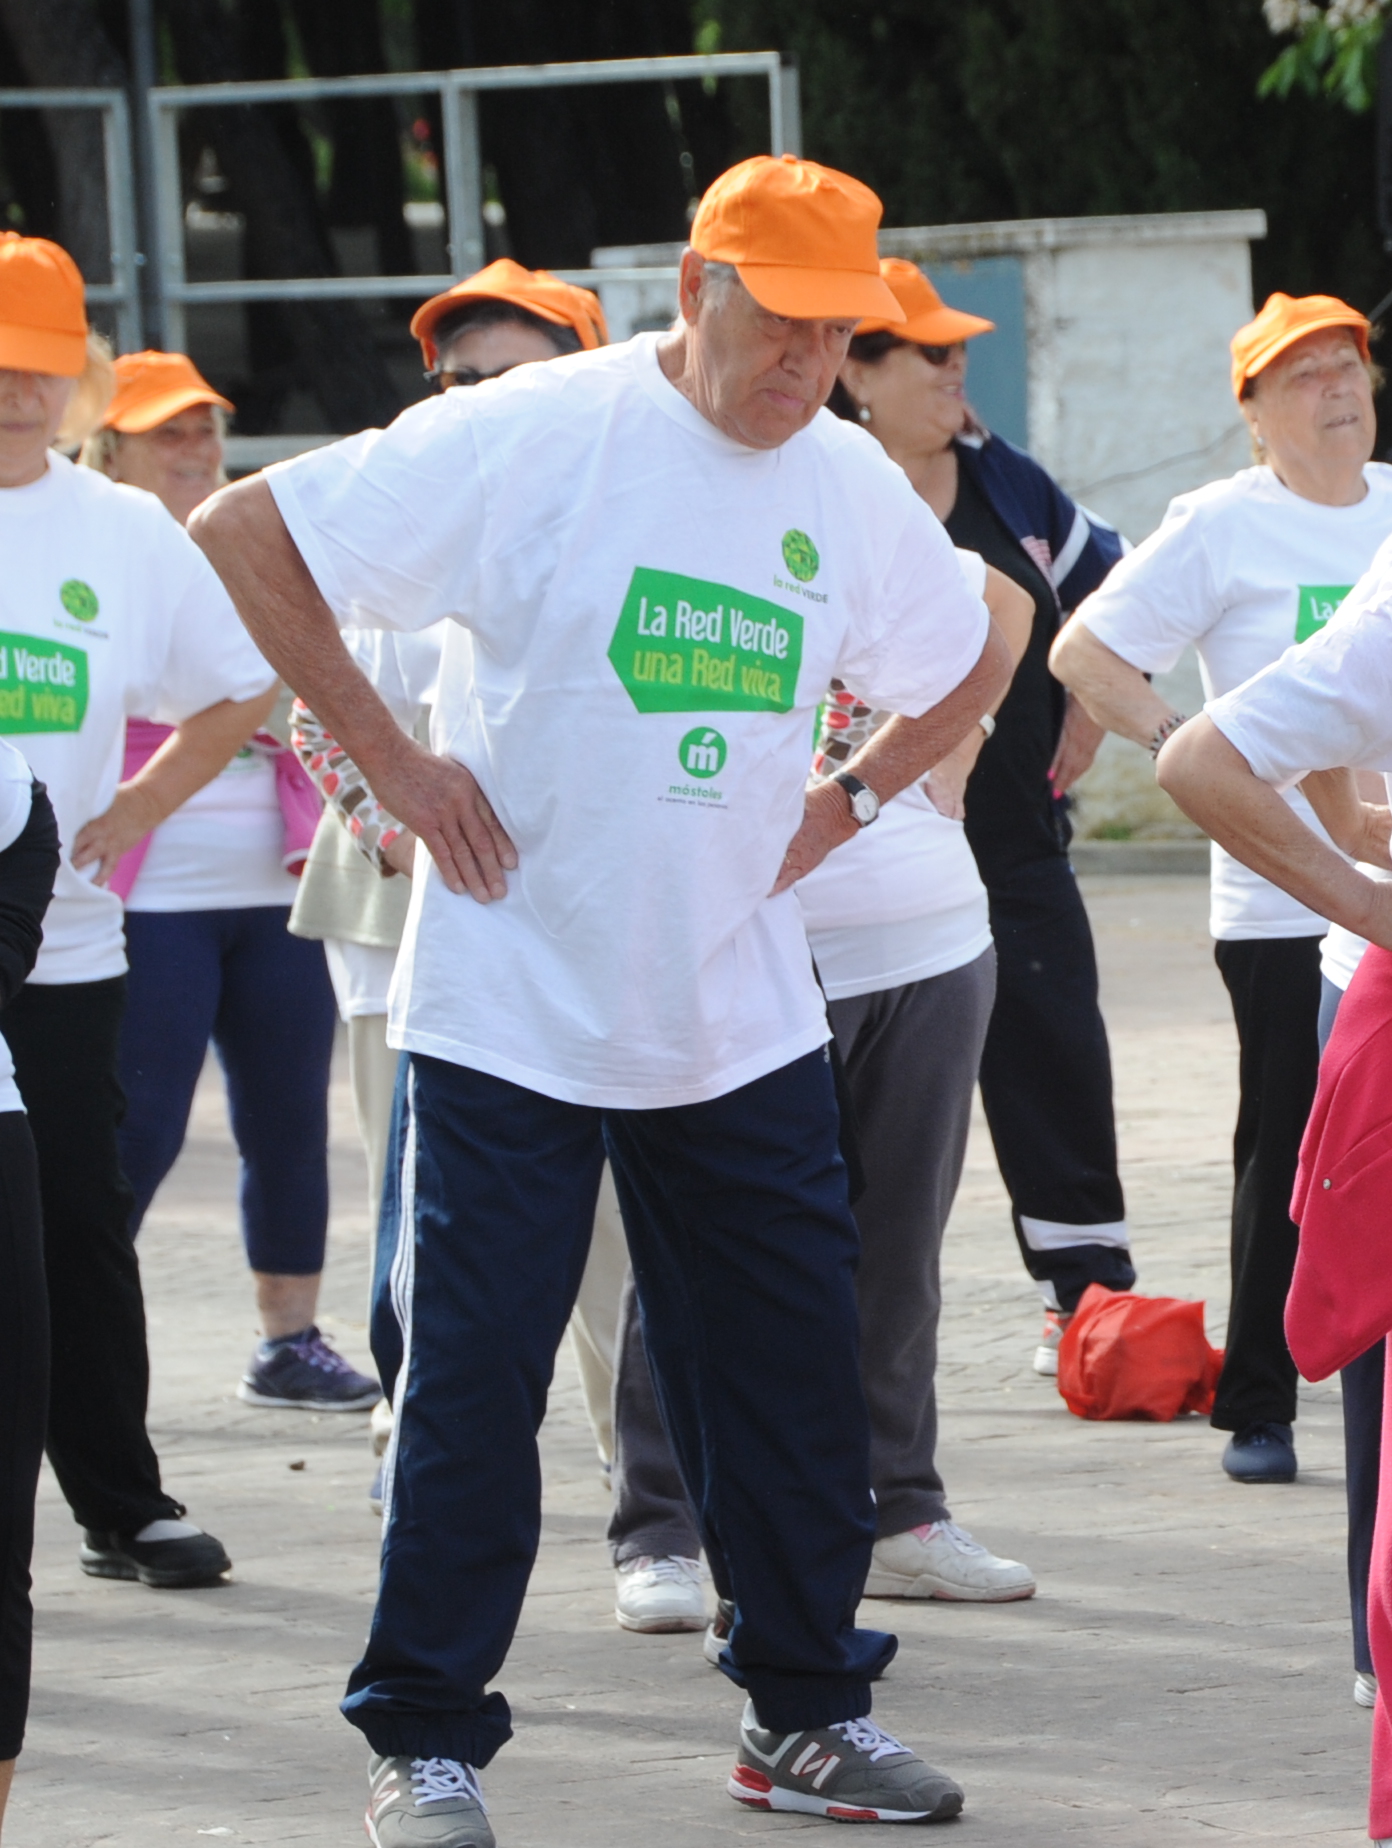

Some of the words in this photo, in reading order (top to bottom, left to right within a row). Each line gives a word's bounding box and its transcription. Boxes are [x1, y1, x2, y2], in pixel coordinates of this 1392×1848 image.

[637, 596, 668, 637] La
[675, 599, 724, 643] Red
[729, 607, 790, 660] Verde
[12, 646, 77, 688] Verde
[632, 649, 685, 686] una
[691, 648, 737, 692] Red
[741, 660, 783, 702] viva
